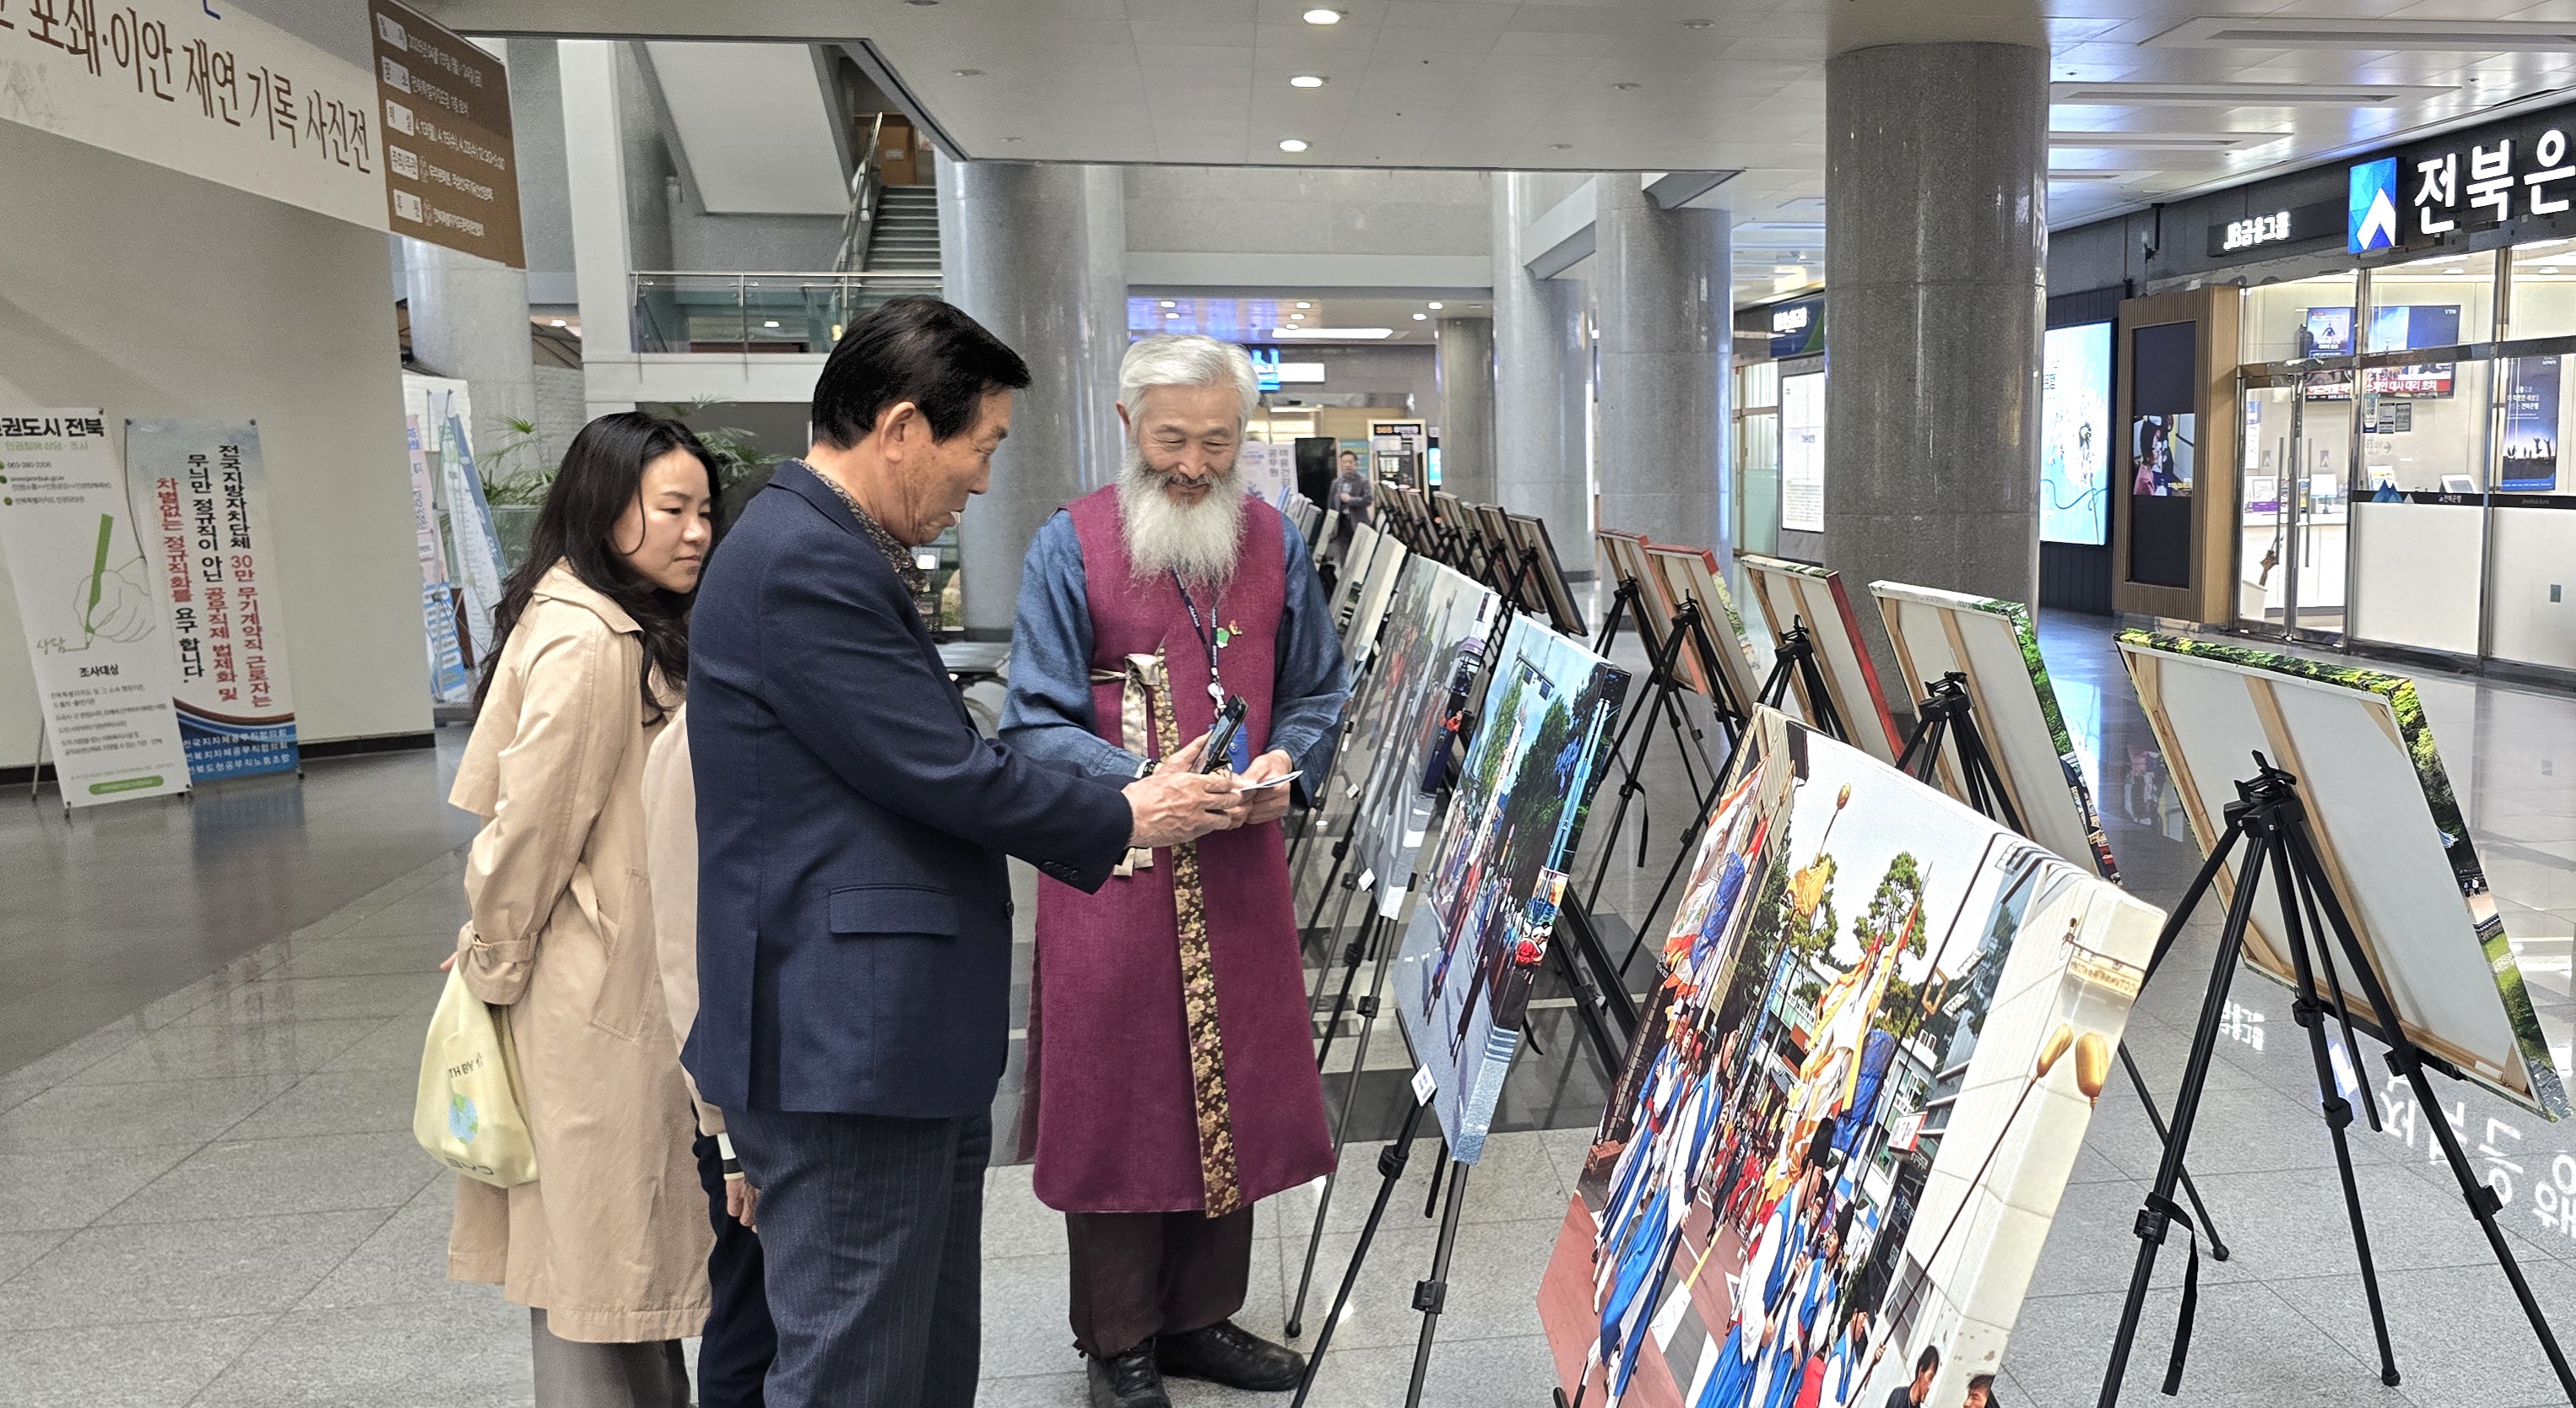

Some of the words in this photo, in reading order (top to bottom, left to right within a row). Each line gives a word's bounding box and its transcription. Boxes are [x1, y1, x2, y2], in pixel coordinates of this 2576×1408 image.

[181, 38, 241, 127] 재연
[247, 67, 297, 149] 기록
[306, 89, 371, 174] 사진전
[2414, 129, 2576, 235] 전북은
[64, 417, 105, 437] 전북
[187, 454, 212, 494] 무늬만
[219, 445, 251, 549] 전국지방자치단체
[156, 477, 184, 531] 차별없는
[193, 498, 218, 551] 정규직이
[202, 555, 223, 582] 아닌
[230, 555, 255, 582] 30만
[175, 607, 198, 634] 요구
[237, 587, 263, 651] 무기계약직
[78, 663, 119, 678] 조사대상
[179, 637, 205, 684] 합니다.
[246, 655, 273, 707] 근로자는
[219, 686, 238, 702] 및
